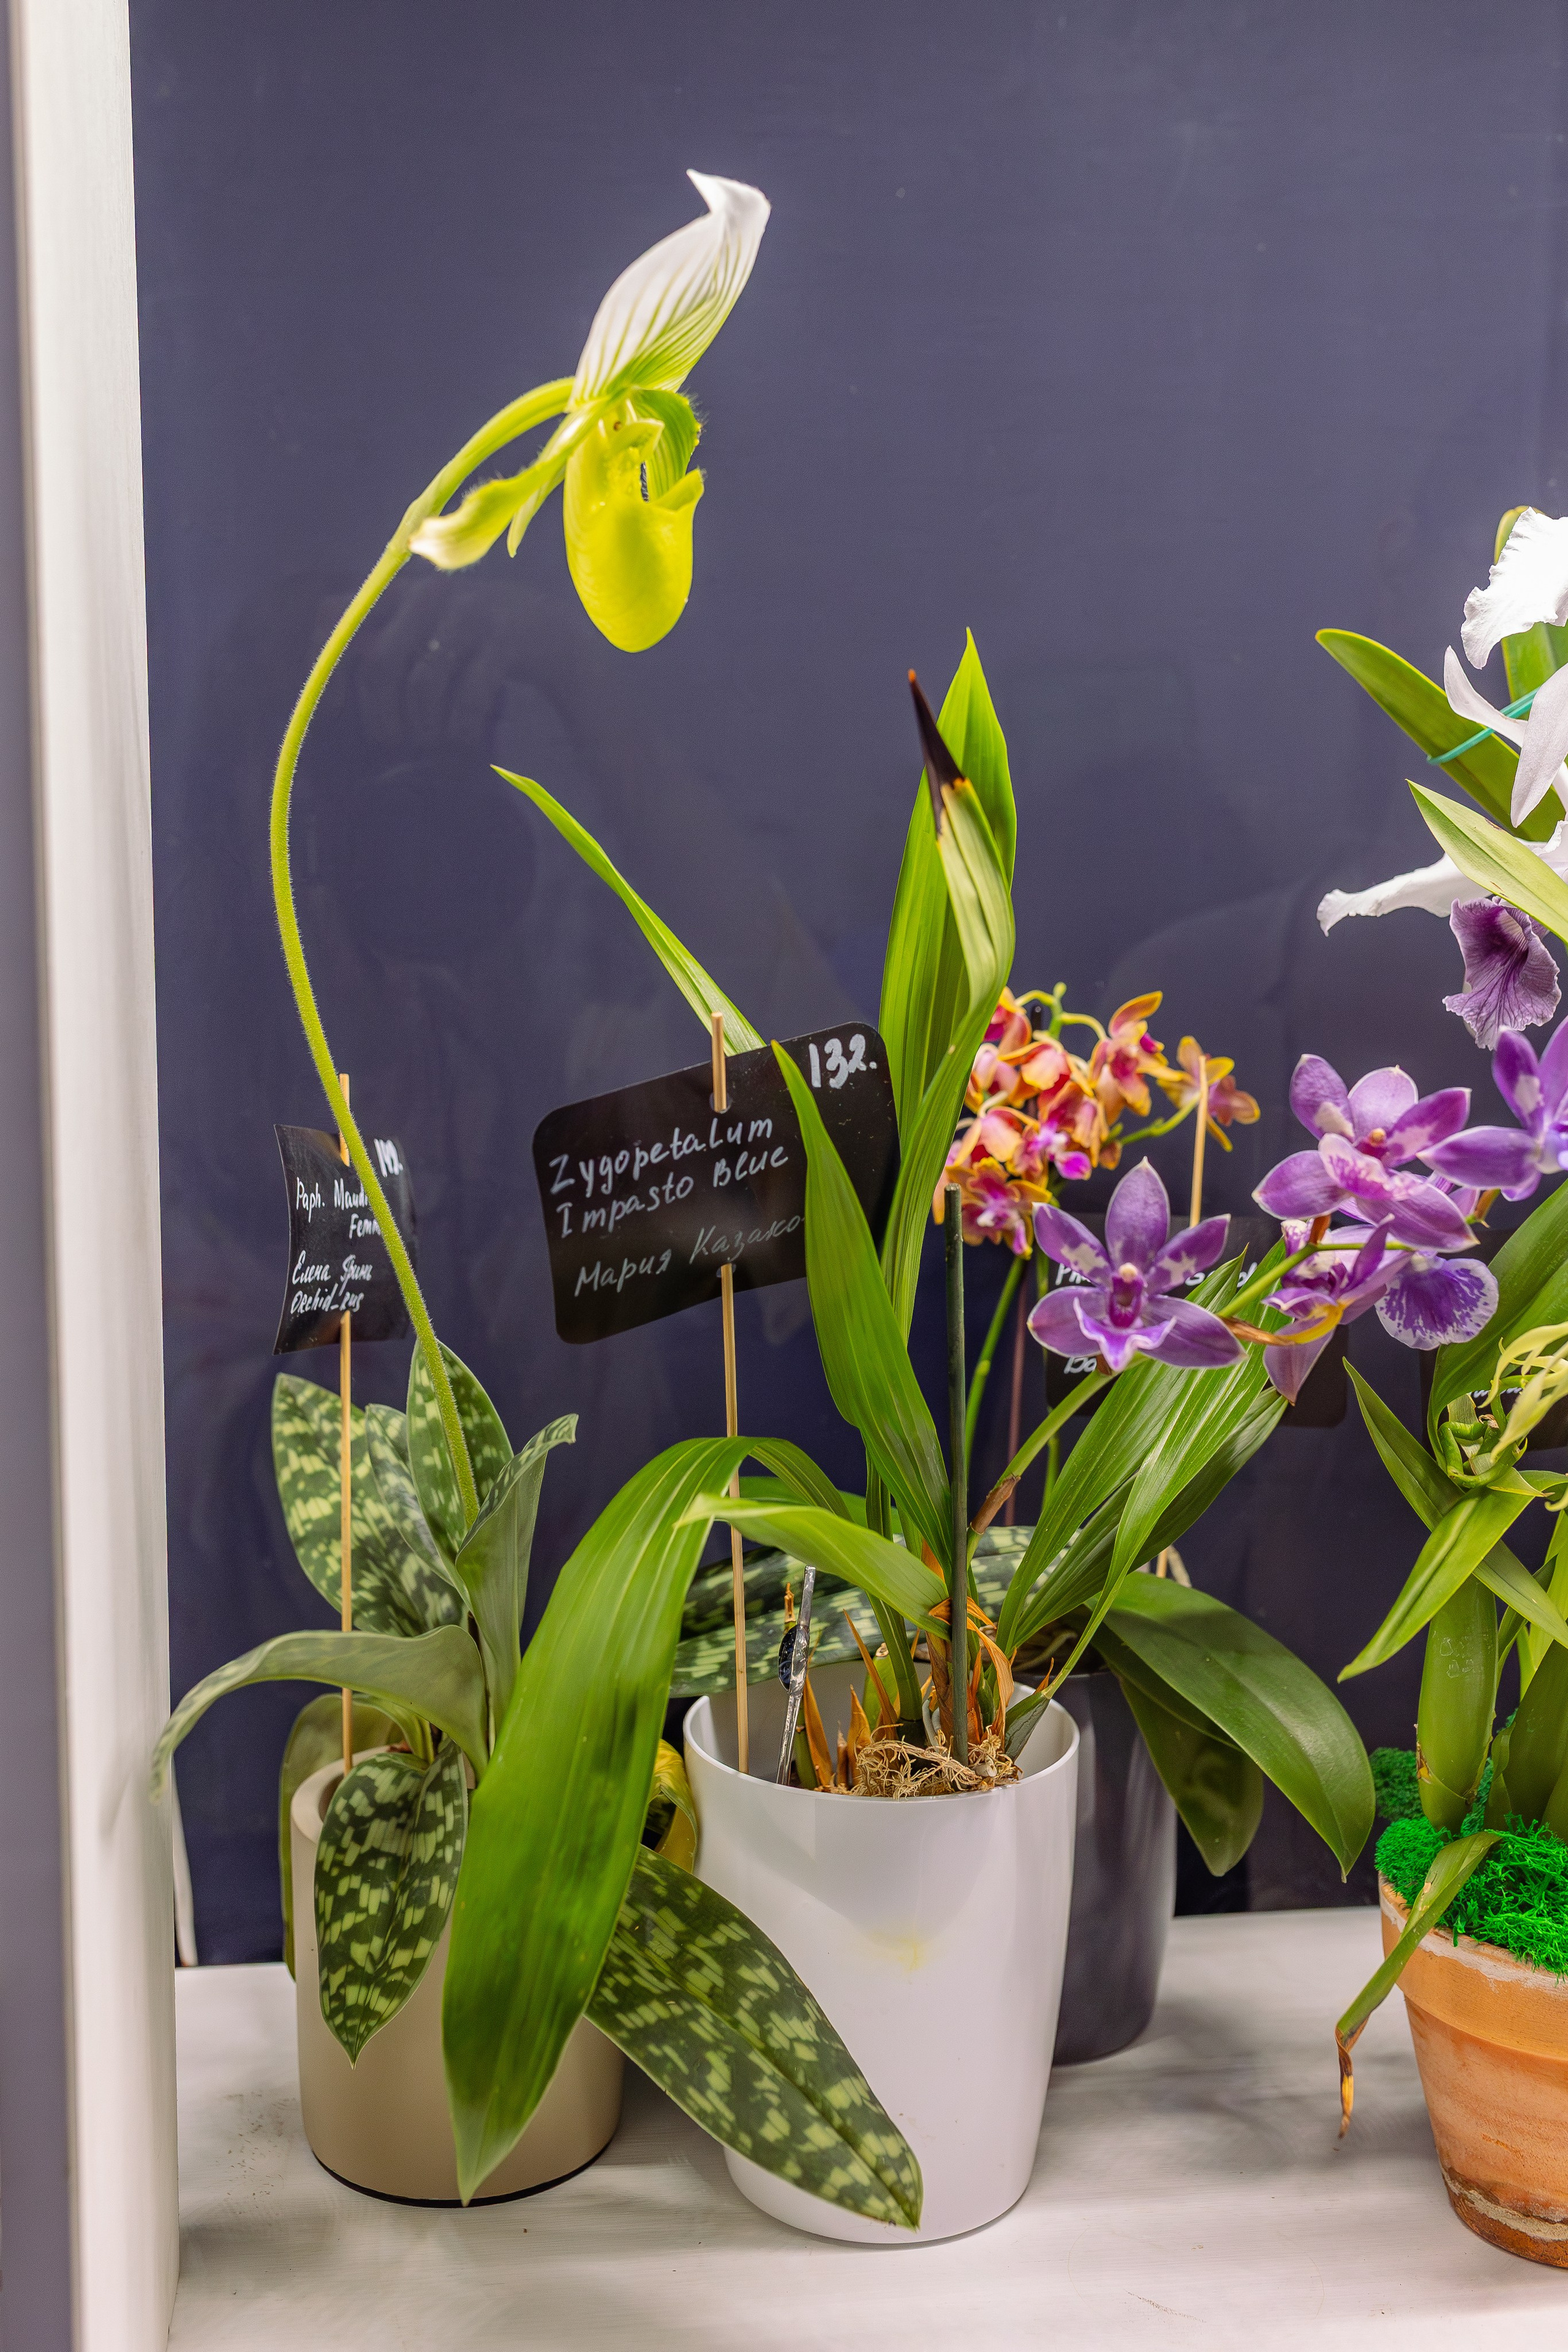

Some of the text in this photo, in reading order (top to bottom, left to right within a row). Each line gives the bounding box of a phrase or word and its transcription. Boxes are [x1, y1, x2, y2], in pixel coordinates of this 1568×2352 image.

[809, 1033, 878, 1090] 132.
[549, 1117, 773, 1199] Zygopetalum
[556, 1145, 789, 1238] Impasto Blue
[295, 1176, 325, 1223] Paph.
[292, 1250, 331, 1285] Елена
[574, 1215, 804, 1297] Мария Казако
